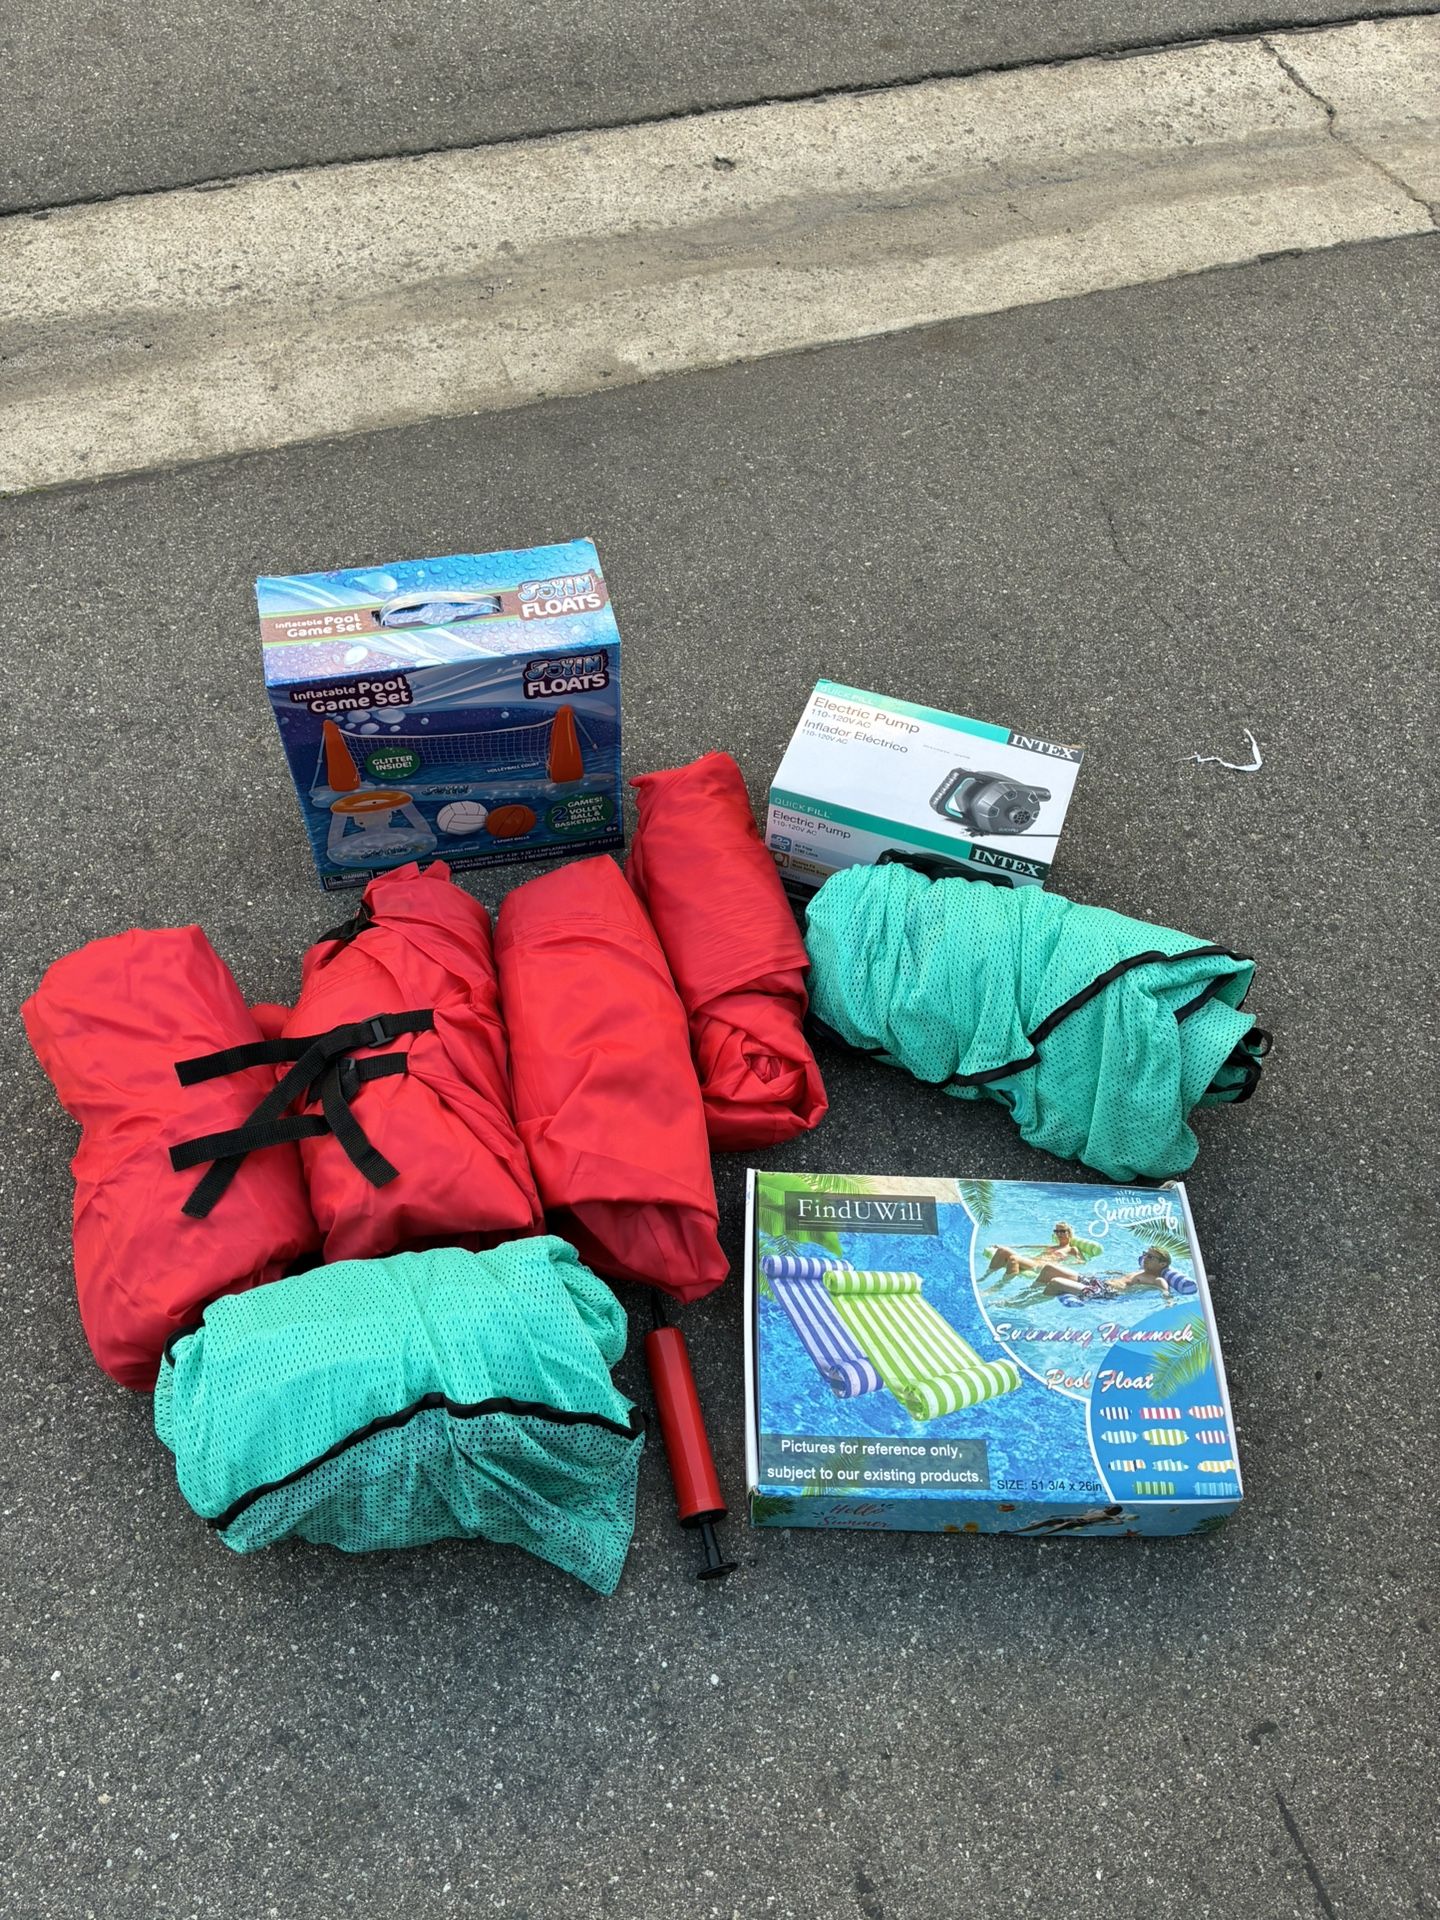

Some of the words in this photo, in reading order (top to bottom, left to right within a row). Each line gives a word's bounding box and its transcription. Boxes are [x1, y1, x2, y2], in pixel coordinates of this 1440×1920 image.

[518, 574, 595, 602] JOYIN
[522, 594, 601, 618] FLOATS
[275, 619, 322, 629] Inflatable
[324, 613, 360, 626] Pool
[286, 626, 332, 638] Game
[336, 623, 363, 632] Set
[525, 654, 603, 680] JOYIN
[293, 686, 356, 701] Inflatable
[358, 677, 406, 694] Pool
[528, 673, 605, 696] FLOATS
[311, 697, 370, 713] Game
[374, 691, 410, 705] Set
[811, 709, 856, 724] 110-120V
[856, 720, 871, 729] AC
[813, 696, 871, 719] Electric
[875, 712, 920, 734] Pump
[801, 729, 835, 742] 110-120V
[804, 719, 852, 737] Inflador
[854, 731, 908, 753] Eléctrico
[1011, 733, 1077, 760] INTEX
[372, 755, 413, 765] GLITTER
[376, 761, 412, 771] INSIDE!
[551, 805, 568, 823] 2
[568, 796, 603, 807] GAMES!
[569, 805, 603, 815] VOLLEY
[571, 812, 592, 820] BALL
[774, 797, 806, 811] QUICK
[807, 806, 830, 818] FILL
[554, 816, 606, 828] BASKETBALL
[773, 810, 815, 828] Electric
[817, 822, 851, 839] Pump
[773, 820, 805, 833] 110-120V
[973, 849, 1039, 877] INTEX
[798, 1199, 923, 1221] FindUWill
[1115, 1197, 1141, 1205] HELLO
[1089, 1197, 1178, 1238] Summer
[1098, 1322, 1194, 1344] Hammock
[1046, 1368, 1091, 1389] Pool
[1099, 1369, 1154, 1392] Float
[781, 1439, 836, 1454] Pictures
[839, 1441, 858, 1454] for
[862, 1443, 926, 1456] reference
[930, 1444, 963, 1459] only,
[767, 1466, 816, 1482] subject
[819, 1468, 833, 1480] to
[837, 1469, 859, 1481] our
[864, 1469, 916, 1484] existing
[921, 1470, 983, 1484] products.
[997, 1479, 1028, 1490] SIZE:
[1031, 1480, 1045, 1490] 51
[1048, 1480, 1066, 1491] 3/4
[1069, 1483, 1076, 1491] x
[1078, 1480, 1102, 1491] 26in
[829, 1503, 886, 1516] Hello
[817, 1516, 889, 1528] Summer
